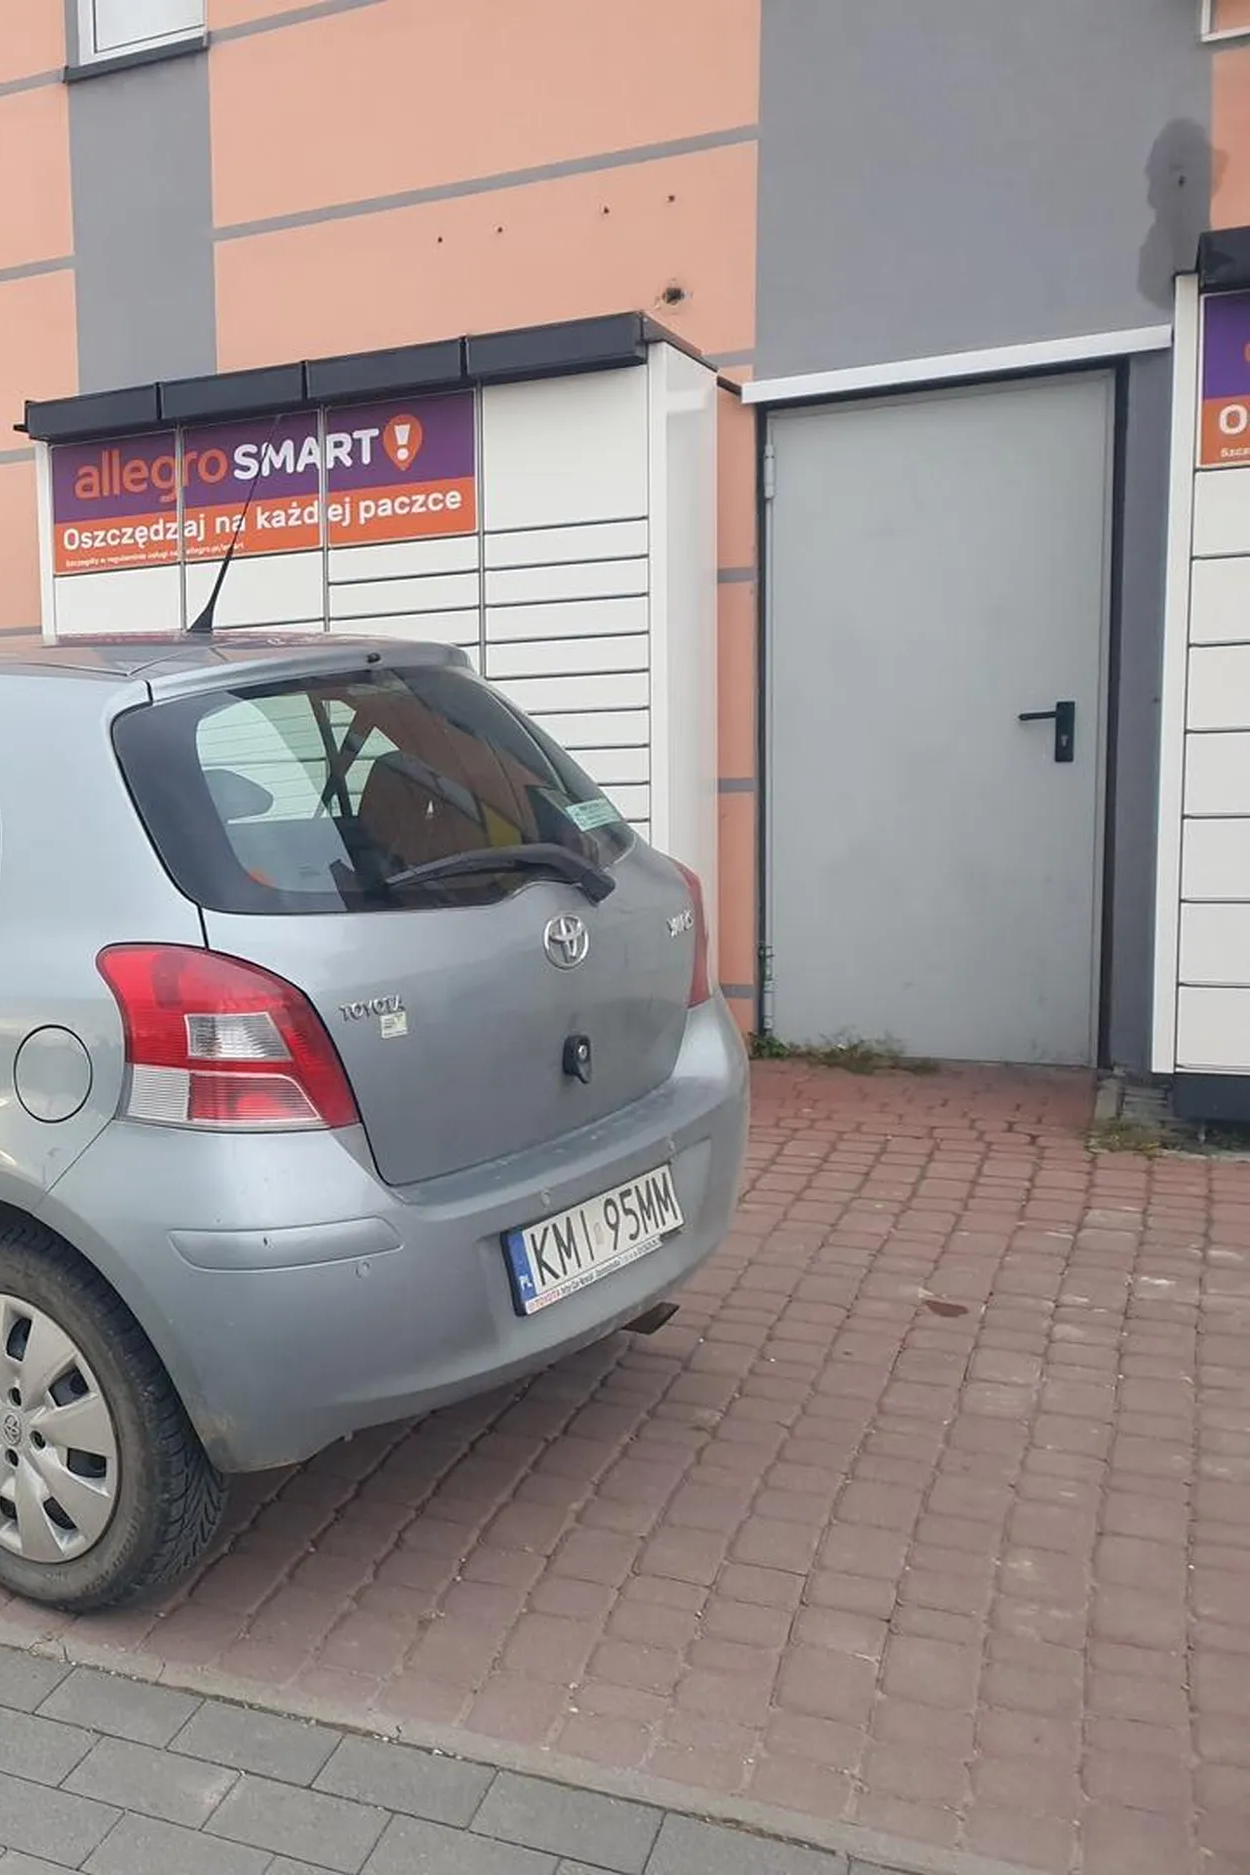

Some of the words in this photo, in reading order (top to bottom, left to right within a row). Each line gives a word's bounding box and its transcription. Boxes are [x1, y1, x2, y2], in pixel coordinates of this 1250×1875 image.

[75, 447, 228, 503] allegro
[63, 513, 206, 550] Oszczędzaj
[215, 513, 247, 535] na
[256, 496, 351, 529] każdej
[358, 489, 462, 525] paczce
[338, 993, 406, 1022] TOYOTA
[531, 1210, 595, 1287] KMI
[603, 1172, 679, 1251] 95MM
